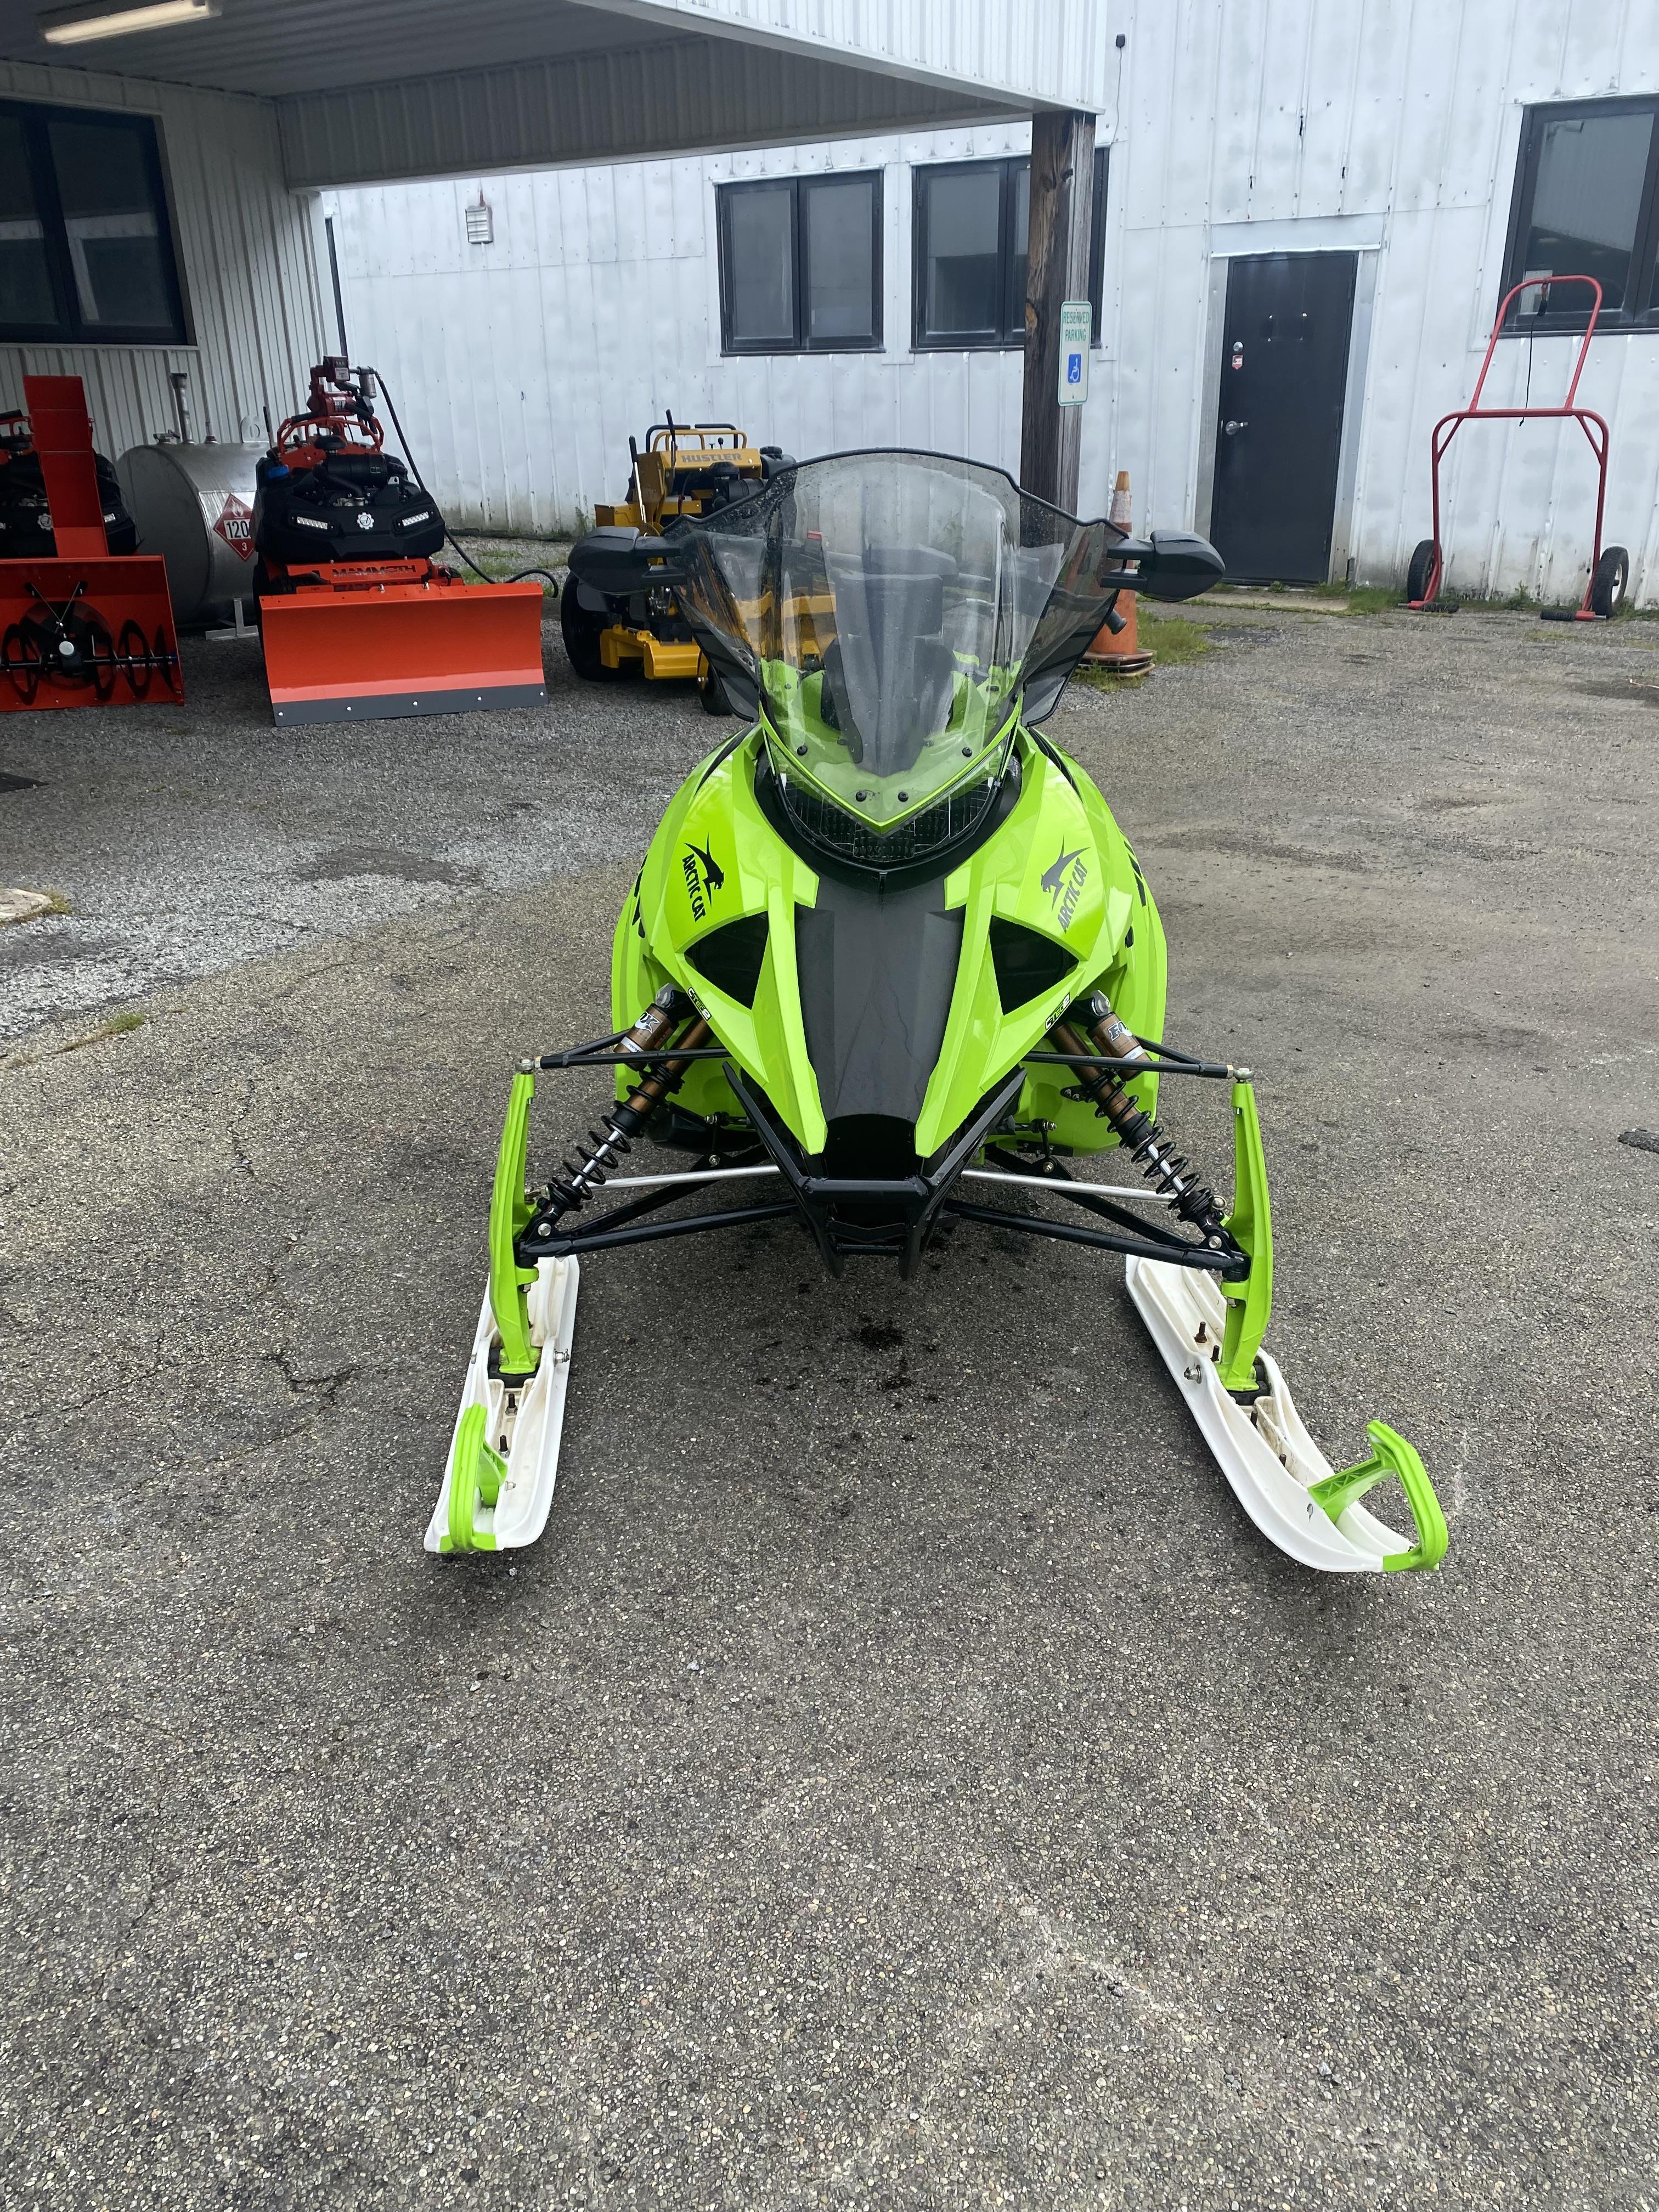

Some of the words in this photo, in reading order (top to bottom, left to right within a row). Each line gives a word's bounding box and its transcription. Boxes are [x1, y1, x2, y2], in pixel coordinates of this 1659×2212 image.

[1063, 311, 1090, 324] RESERVED
[1065, 329, 1086, 342] PARKING
[681, 453, 742, 462] HUSTLER
[241, 542, 247, 551] 3
[331, 565, 416, 577] MAMMOTH
[682, 853, 701, 899] ARCTIC
[692, 895, 706, 922] CAT
[1057, 879, 1080, 934] ARCTIC
[1072, 857, 1088, 887] CAT
